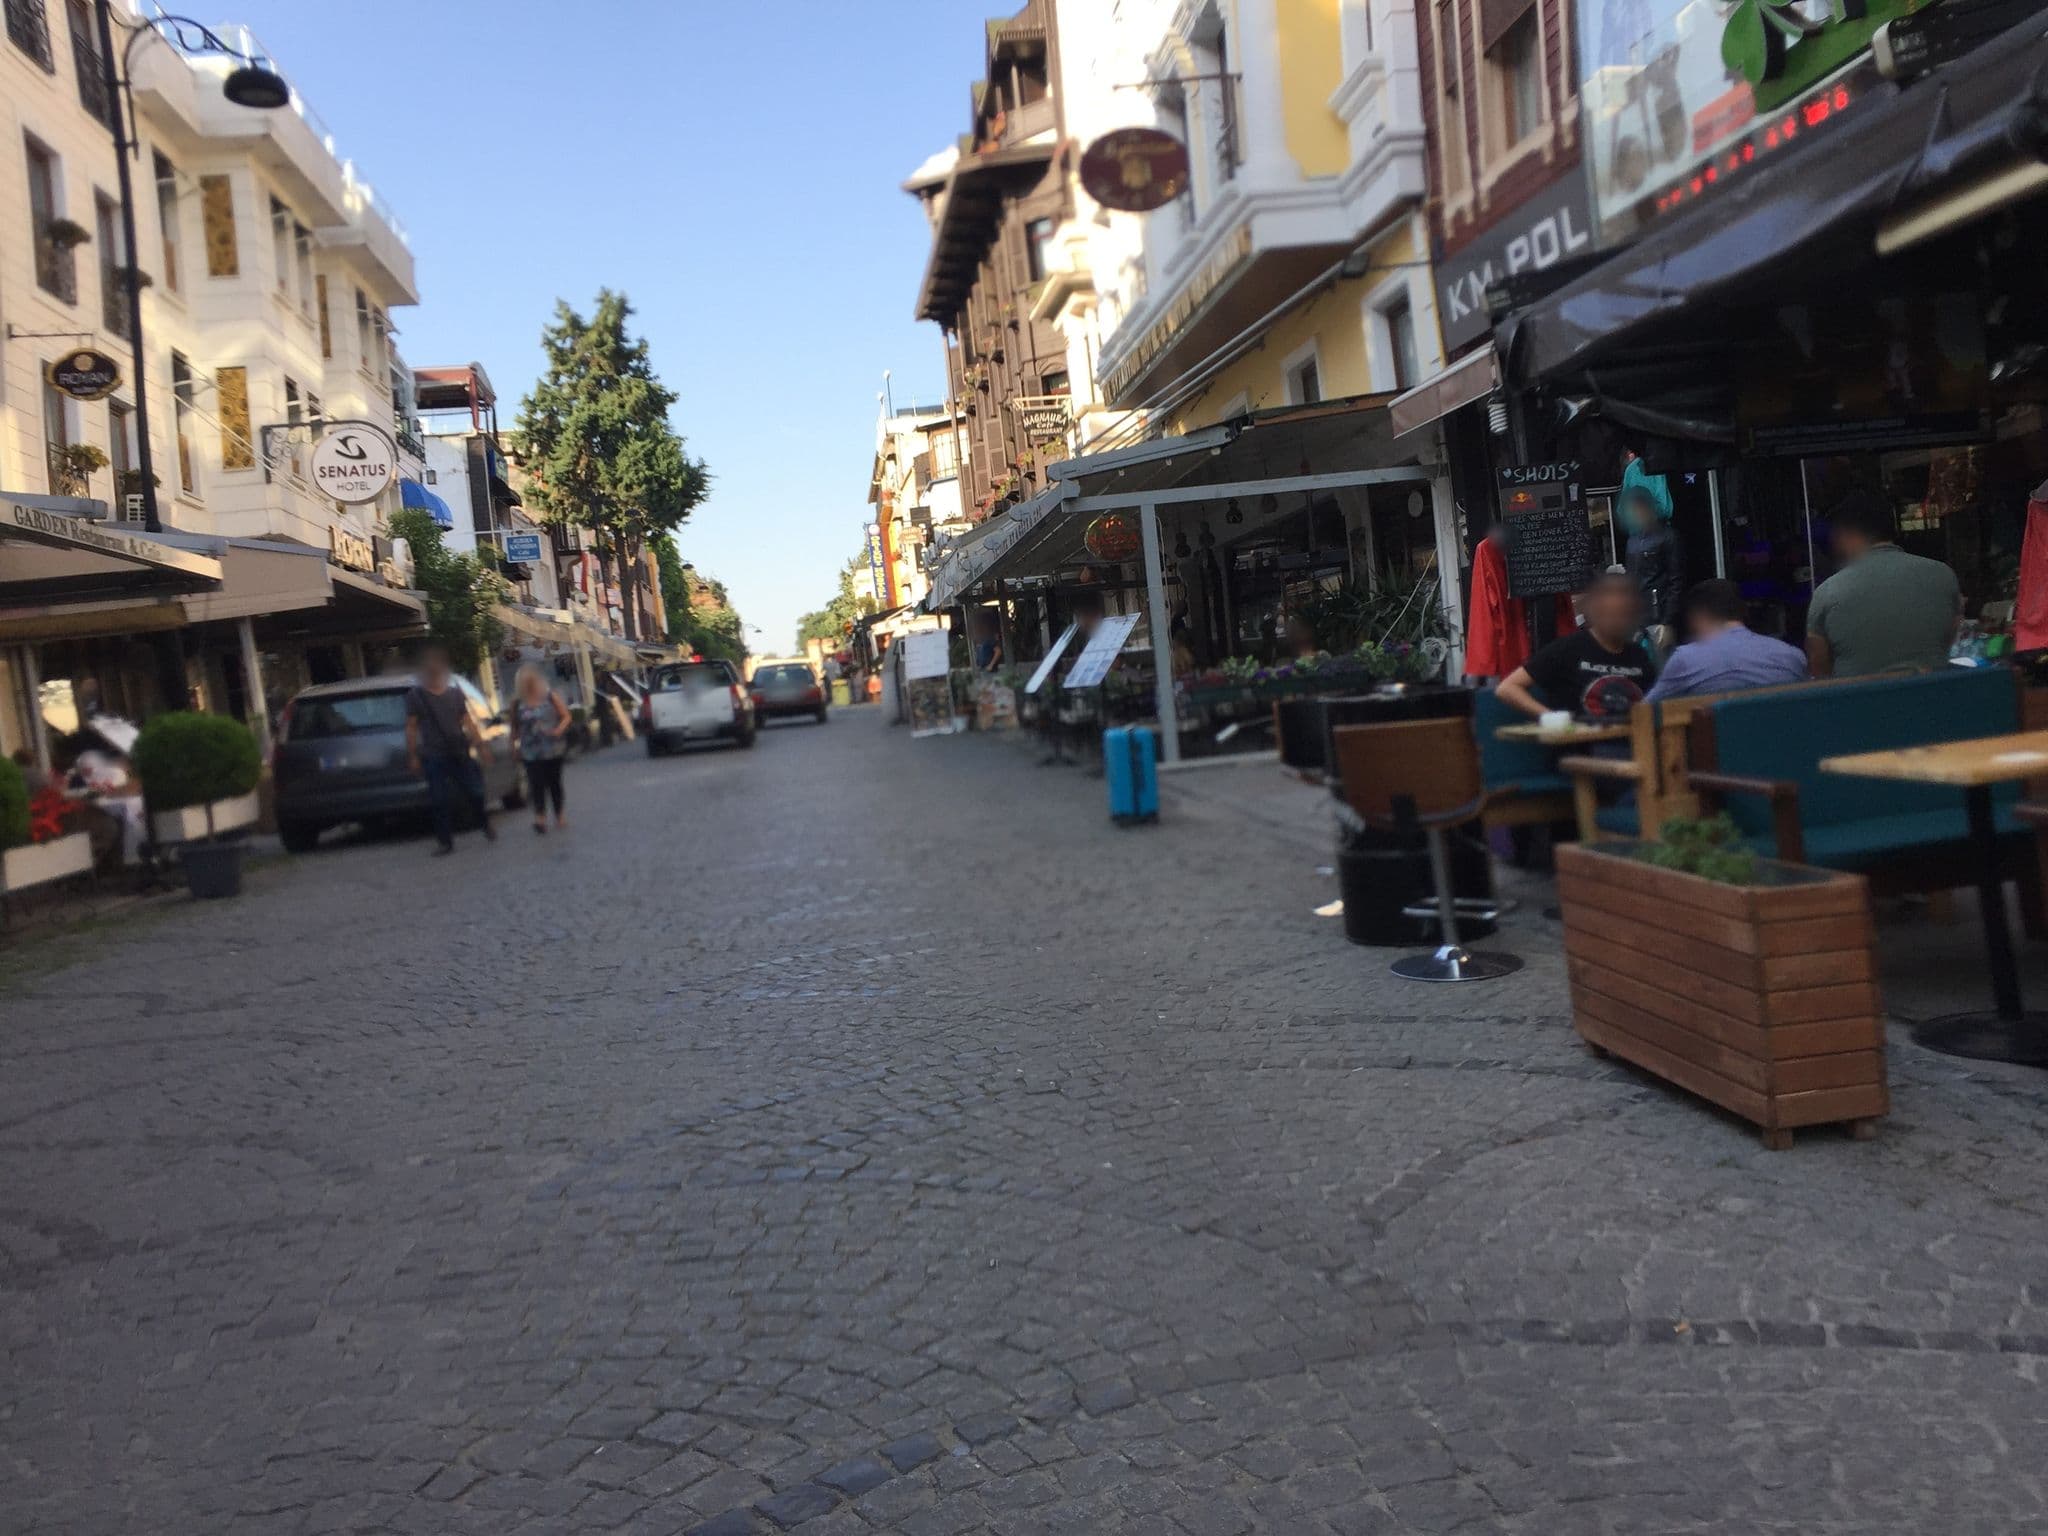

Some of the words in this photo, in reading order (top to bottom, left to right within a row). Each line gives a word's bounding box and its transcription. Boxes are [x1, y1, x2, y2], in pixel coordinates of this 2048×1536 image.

[1507, 207, 1588, 275] POL
[1023, 412, 1067, 428] MAGNAURA
[319, 463, 386, 479] SENATUS
[336, 481, 371, 491] HOTEL
[14, 505, 68, 535] GARDEN
